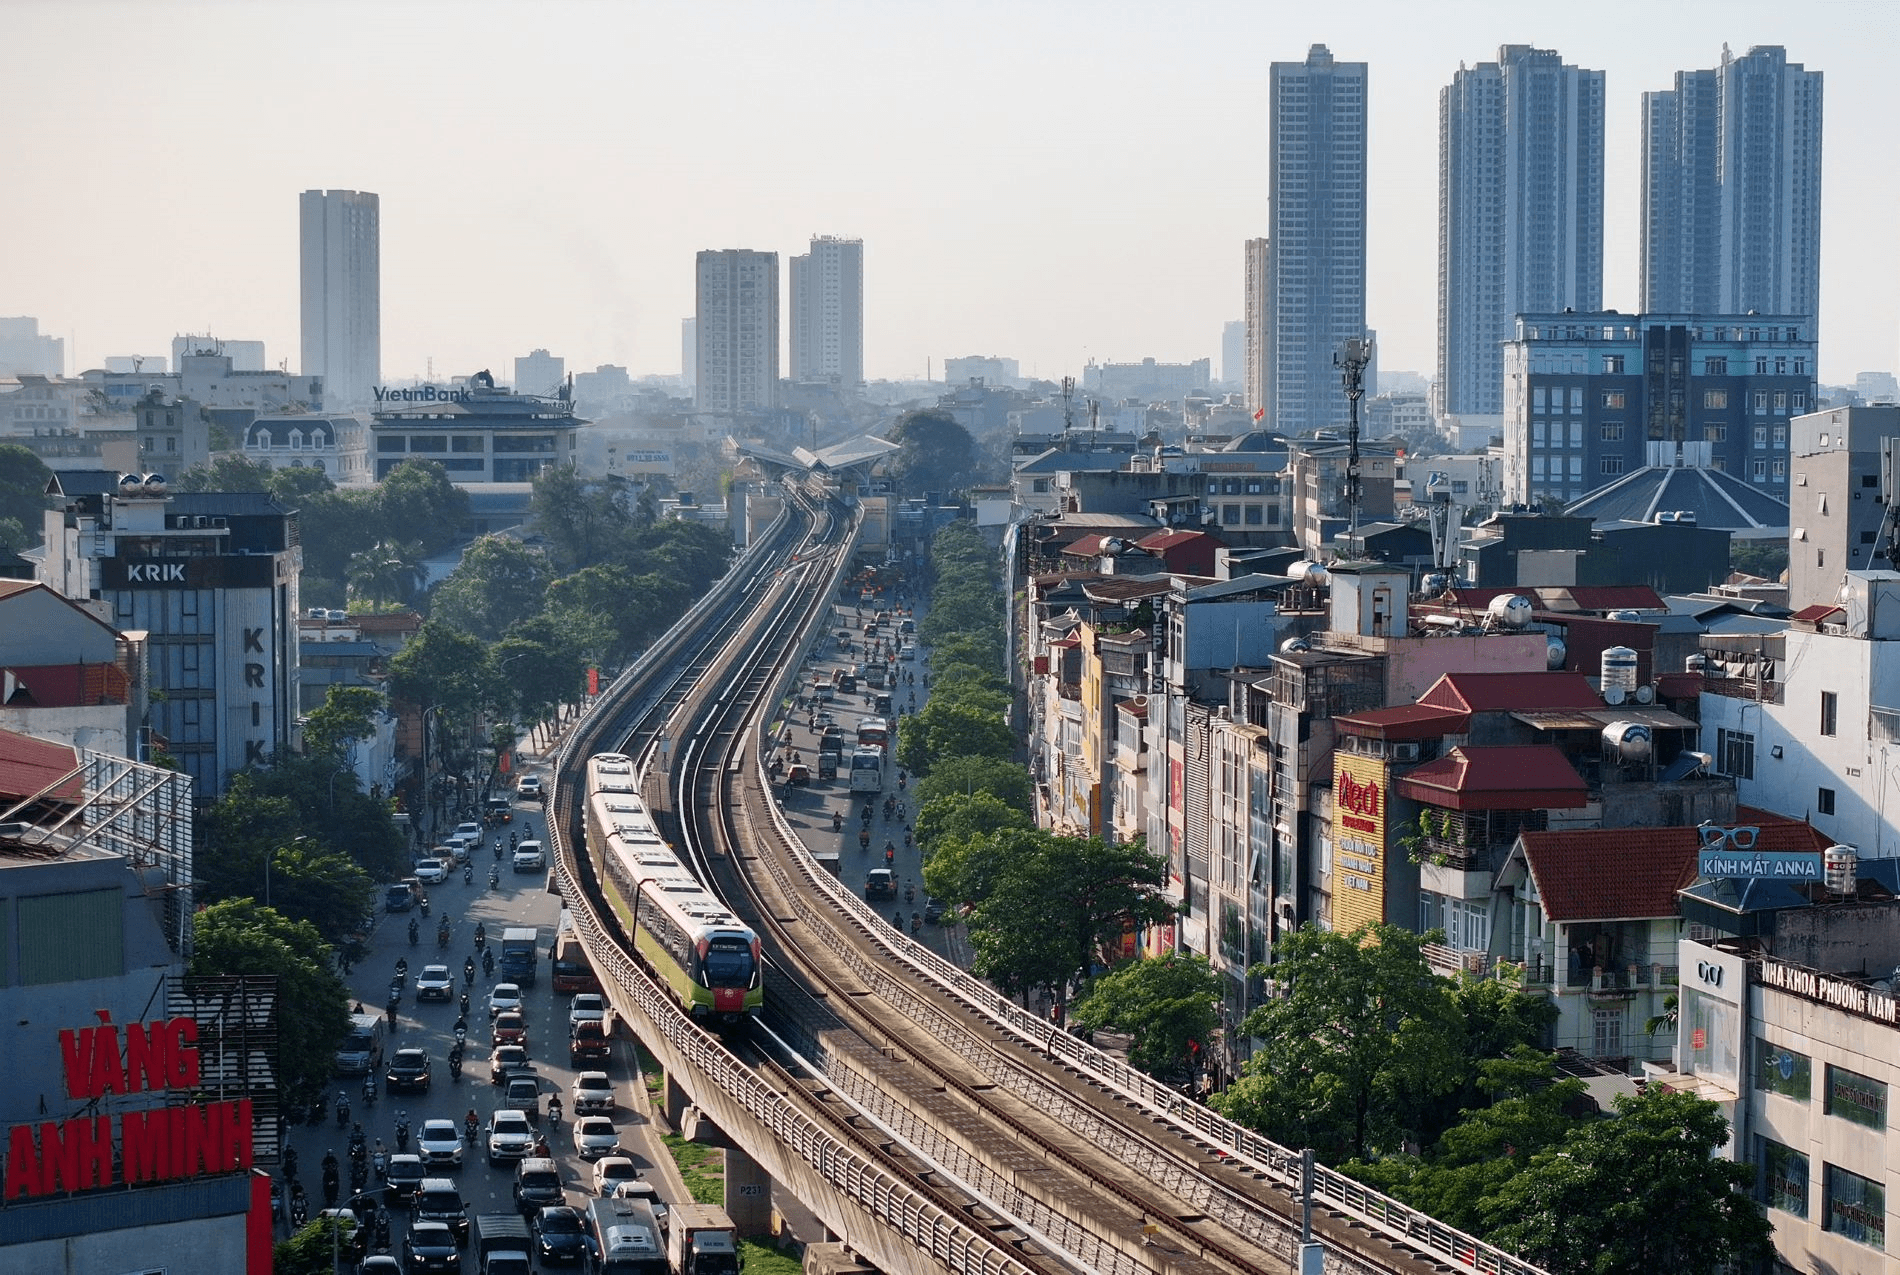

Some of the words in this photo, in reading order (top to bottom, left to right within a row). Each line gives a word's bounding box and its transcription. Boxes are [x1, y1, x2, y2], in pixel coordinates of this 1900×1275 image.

[372, 386, 471, 401] VietinBank
[127, 563, 186, 582] KRIK
[243, 628, 266, 764] KRIK
[1704, 855, 1737, 874] KÍNH
[1740, 853, 1770, 875] MẮT
[1774, 860, 1816, 876] ANNA
[1762, 960, 1784, 988] NHA
[1786, 967, 1816, 998] KHOA
[1819, 977, 1865, 1013] PHƯƠNG
[1867, 992, 1896, 1023] NAM
[58, 1009, 200, 1099] VÀNG
[4, 1115, 113, 1199] ANH
[121, 1098, 253, 1184] MINH
[740, 1185, 761, 1195] P231
[1782, 1178, 1803, 1201] KHOA
